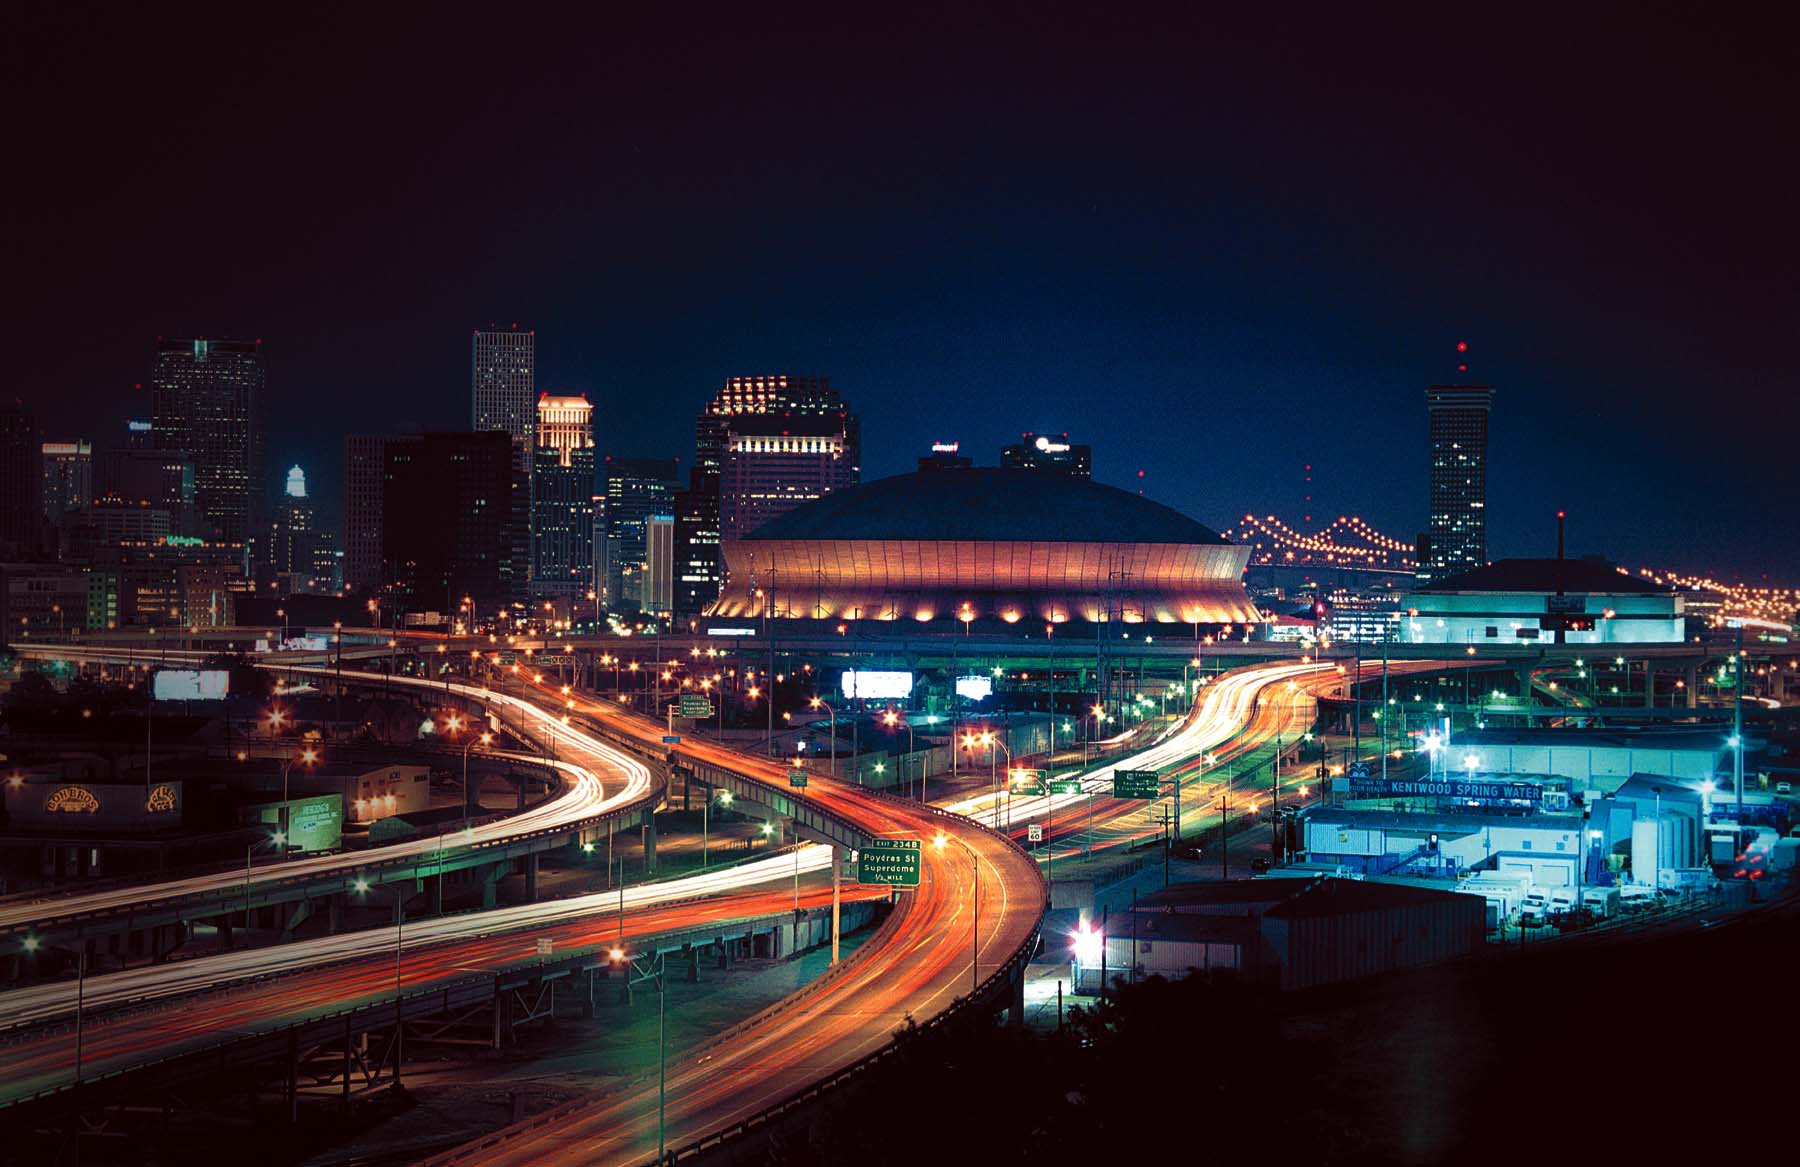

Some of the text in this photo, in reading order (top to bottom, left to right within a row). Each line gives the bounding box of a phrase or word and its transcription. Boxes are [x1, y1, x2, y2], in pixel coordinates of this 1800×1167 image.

[1391, 782, 1540, 798] KENTWOOD SPRING WATER
[864, 854, 915, 863] Poydras St
[864, 865, 914, 873] Superdome
